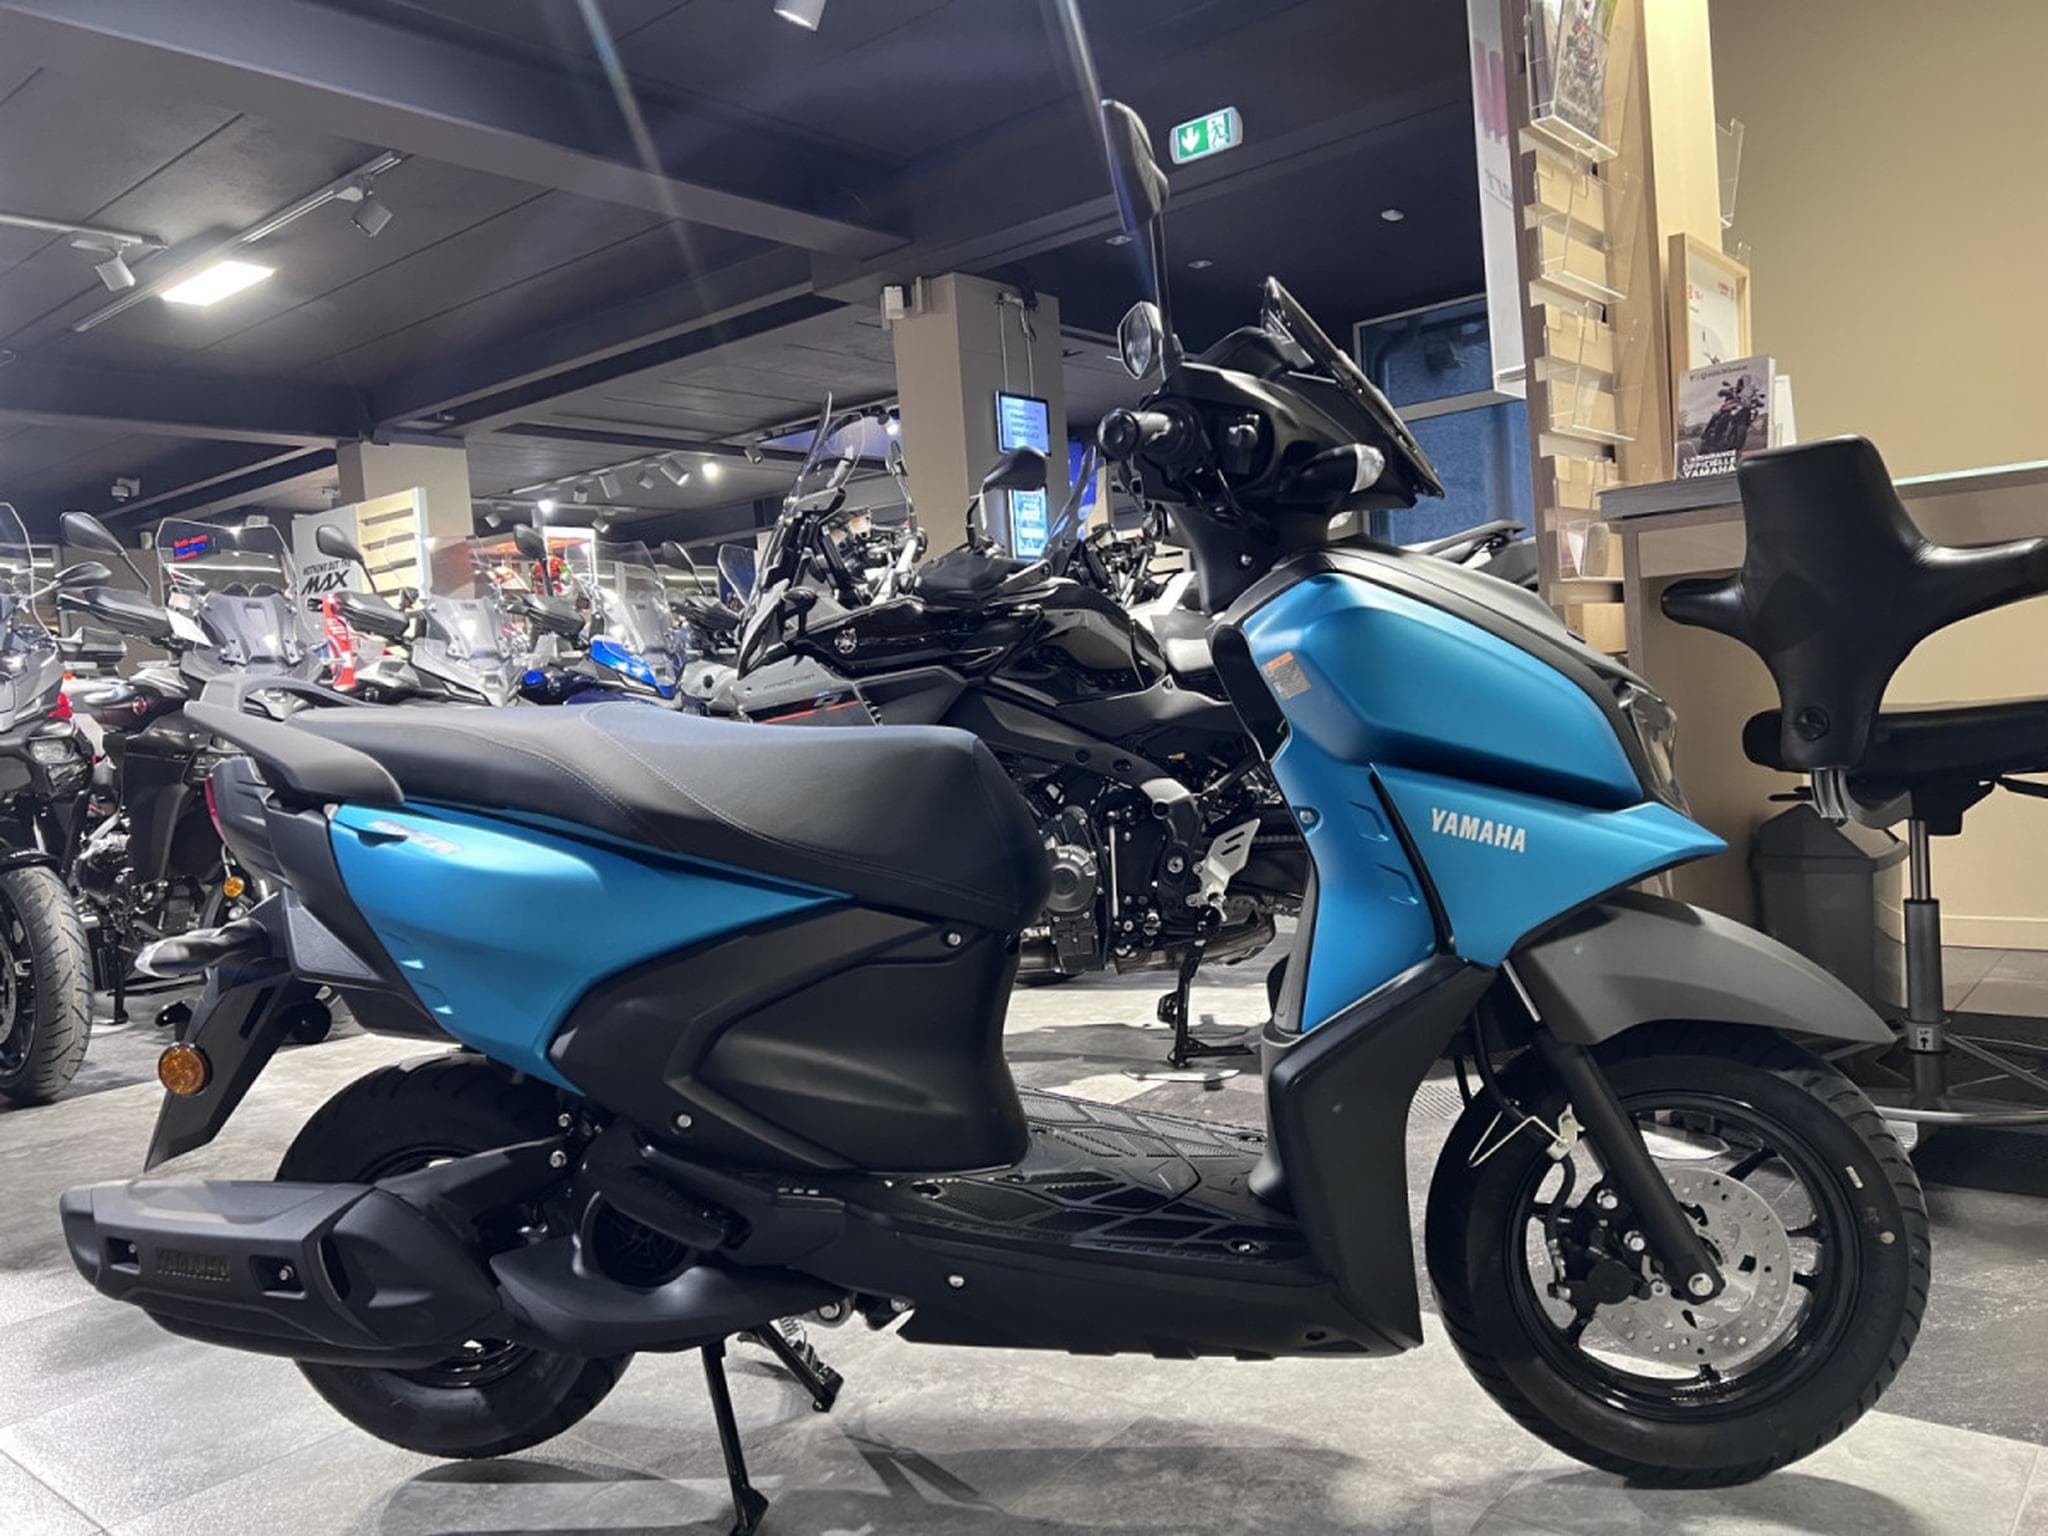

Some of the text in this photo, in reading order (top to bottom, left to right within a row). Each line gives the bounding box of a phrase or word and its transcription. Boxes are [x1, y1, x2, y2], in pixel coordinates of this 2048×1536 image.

[1682, 457, 1737, 472] OFFICIELLE
[1683, 464, 1737, 478] YAMAHA
[301, 569, 350, 596] MAX
[1431, 807, 1526, 853] YAMAHA
